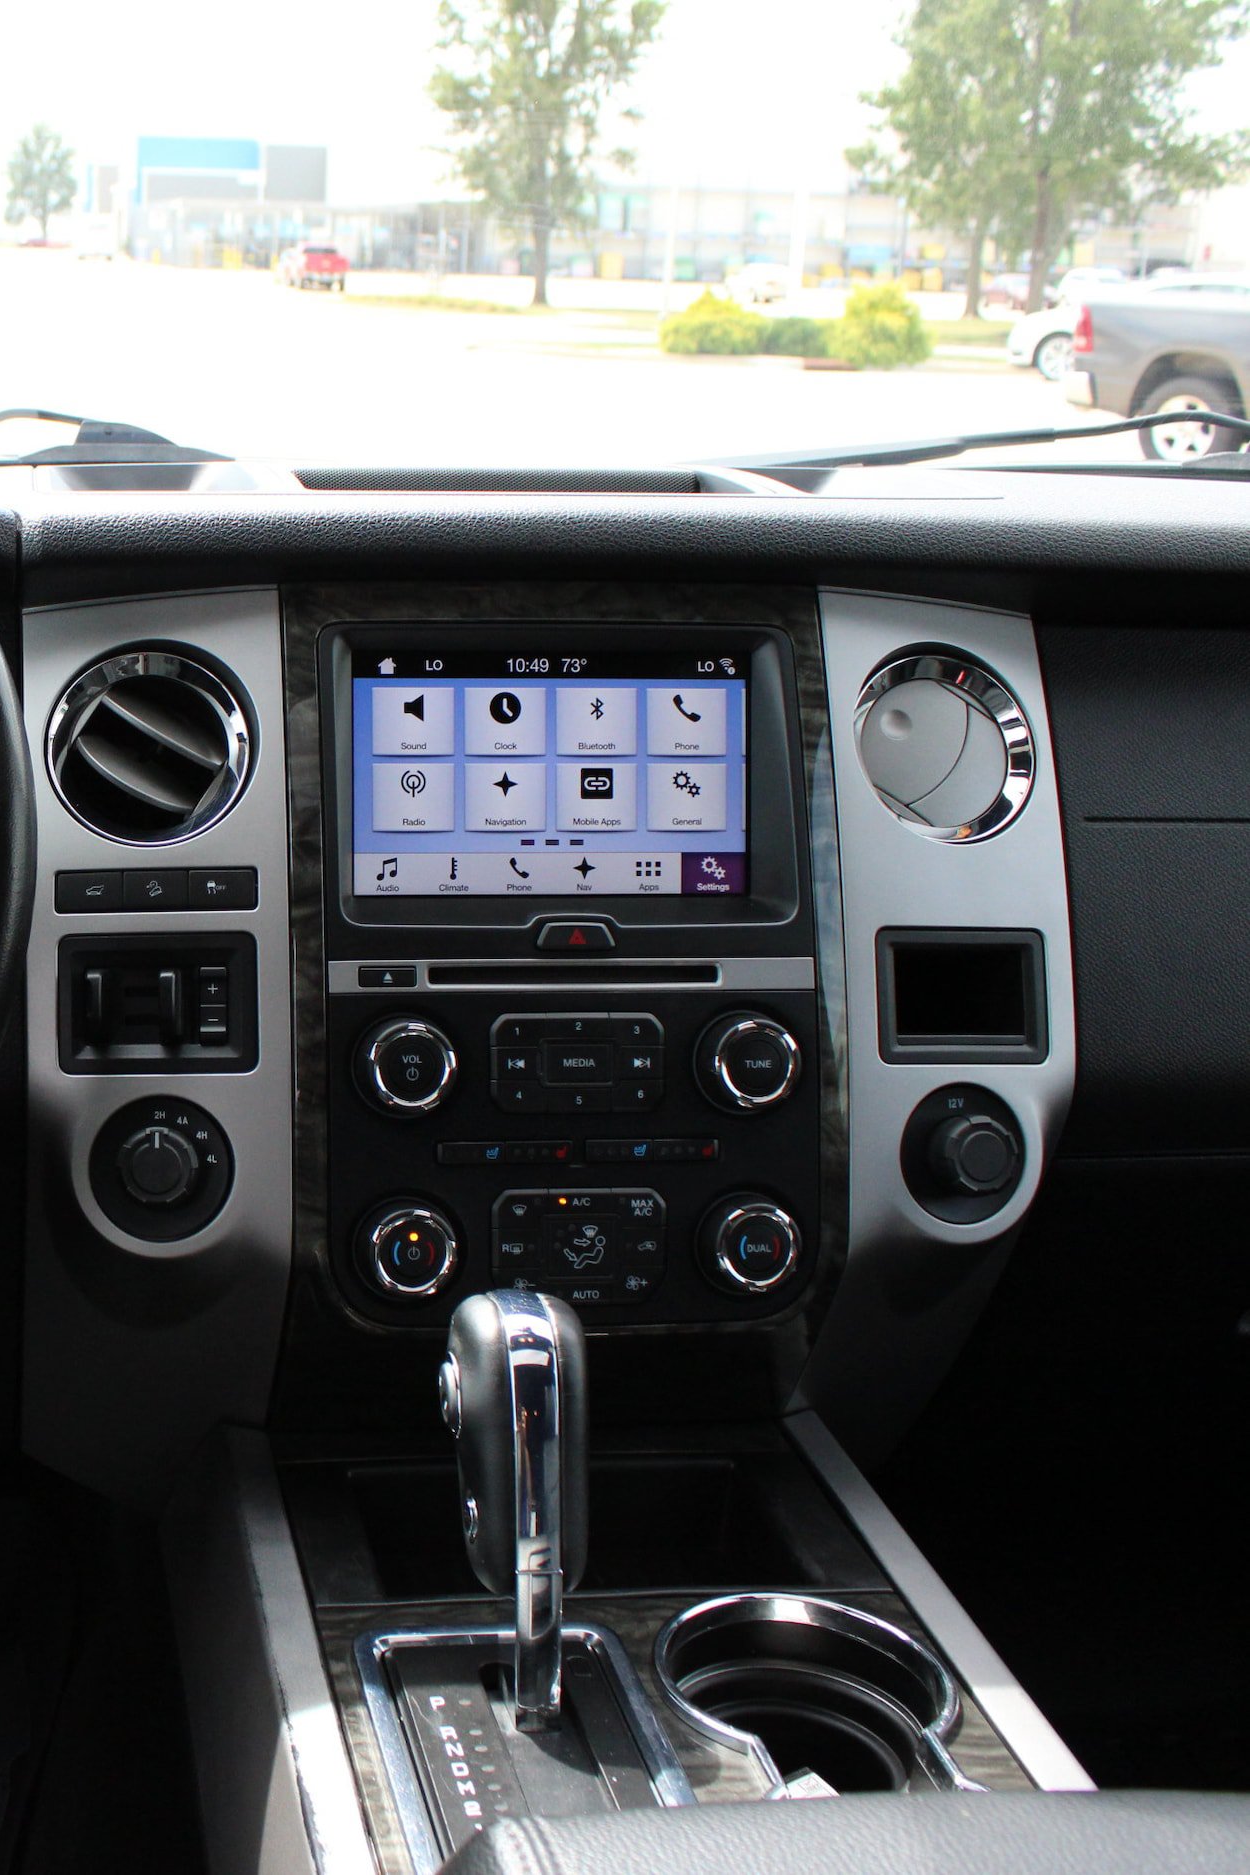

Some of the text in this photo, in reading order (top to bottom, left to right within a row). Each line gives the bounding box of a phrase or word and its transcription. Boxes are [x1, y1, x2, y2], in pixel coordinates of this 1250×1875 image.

[425, 660, 444, 672] LO
[506, 658, 588, 672] 10:49 73°
[698, 660, 715, 672] LO
[400, 742, 427, 750] Sound
[494, 742, 518, 750] Clock
[578, 742, 616, 750] Bluetooth
[674, 742, 700, 750] Phone
[402, 818, 426, 826] Radio
[485, 818, 527, 828] Navigation
[572, 818, 622, 828] Mobile Apps
[672, 818, 702, 826] General
[376, 884, 400, 892] Audio
[438, 884, 469, 892] Climate
[506, 884, 532, 892] Phone
[576, 884, 592, 892] Nav
[638, 884, 660, 894] Apps
[697, 882, 730, 893] Settings
[575, 1022, 582, 1030] 2
[634, 1026, 640, 1034] 3
[514, 1028, 520, 1036] 1
[402, 1055, 422, 1064] VOL
[563, 1058, 596, 1068] MEDIA
[745, 1060, 772, 1068] TUNE
[516, 1090, 522, 1099] 4
[638, 1090, 644, 1098] 6
[576, 1096, 582, 1105] 5
[948, 1098, 964, 1109] 12V
[154, 1110, 166, 1120] 2H
[176, 1116, 188, 1124] 4A
[196, 1130, 208, 1140] 4H
[206, 1154, 218, 1164] 4L
[572, 1198, 591, 1206] A/C
[631, 1200, 654, 1208] MAX
[634, 1208, 652, 1216] A/C
[747, 1244, 771, 1252] DUAL
[572, 1290, 600, 1300] AUTO
[430, 1696, 446, 1711] P
[440, 1726, 458, 1740] R
[445, 1742, 465, 1757] N
[451, 1762, 470, 1777] D
[456, 1781, 476, 1796] M
